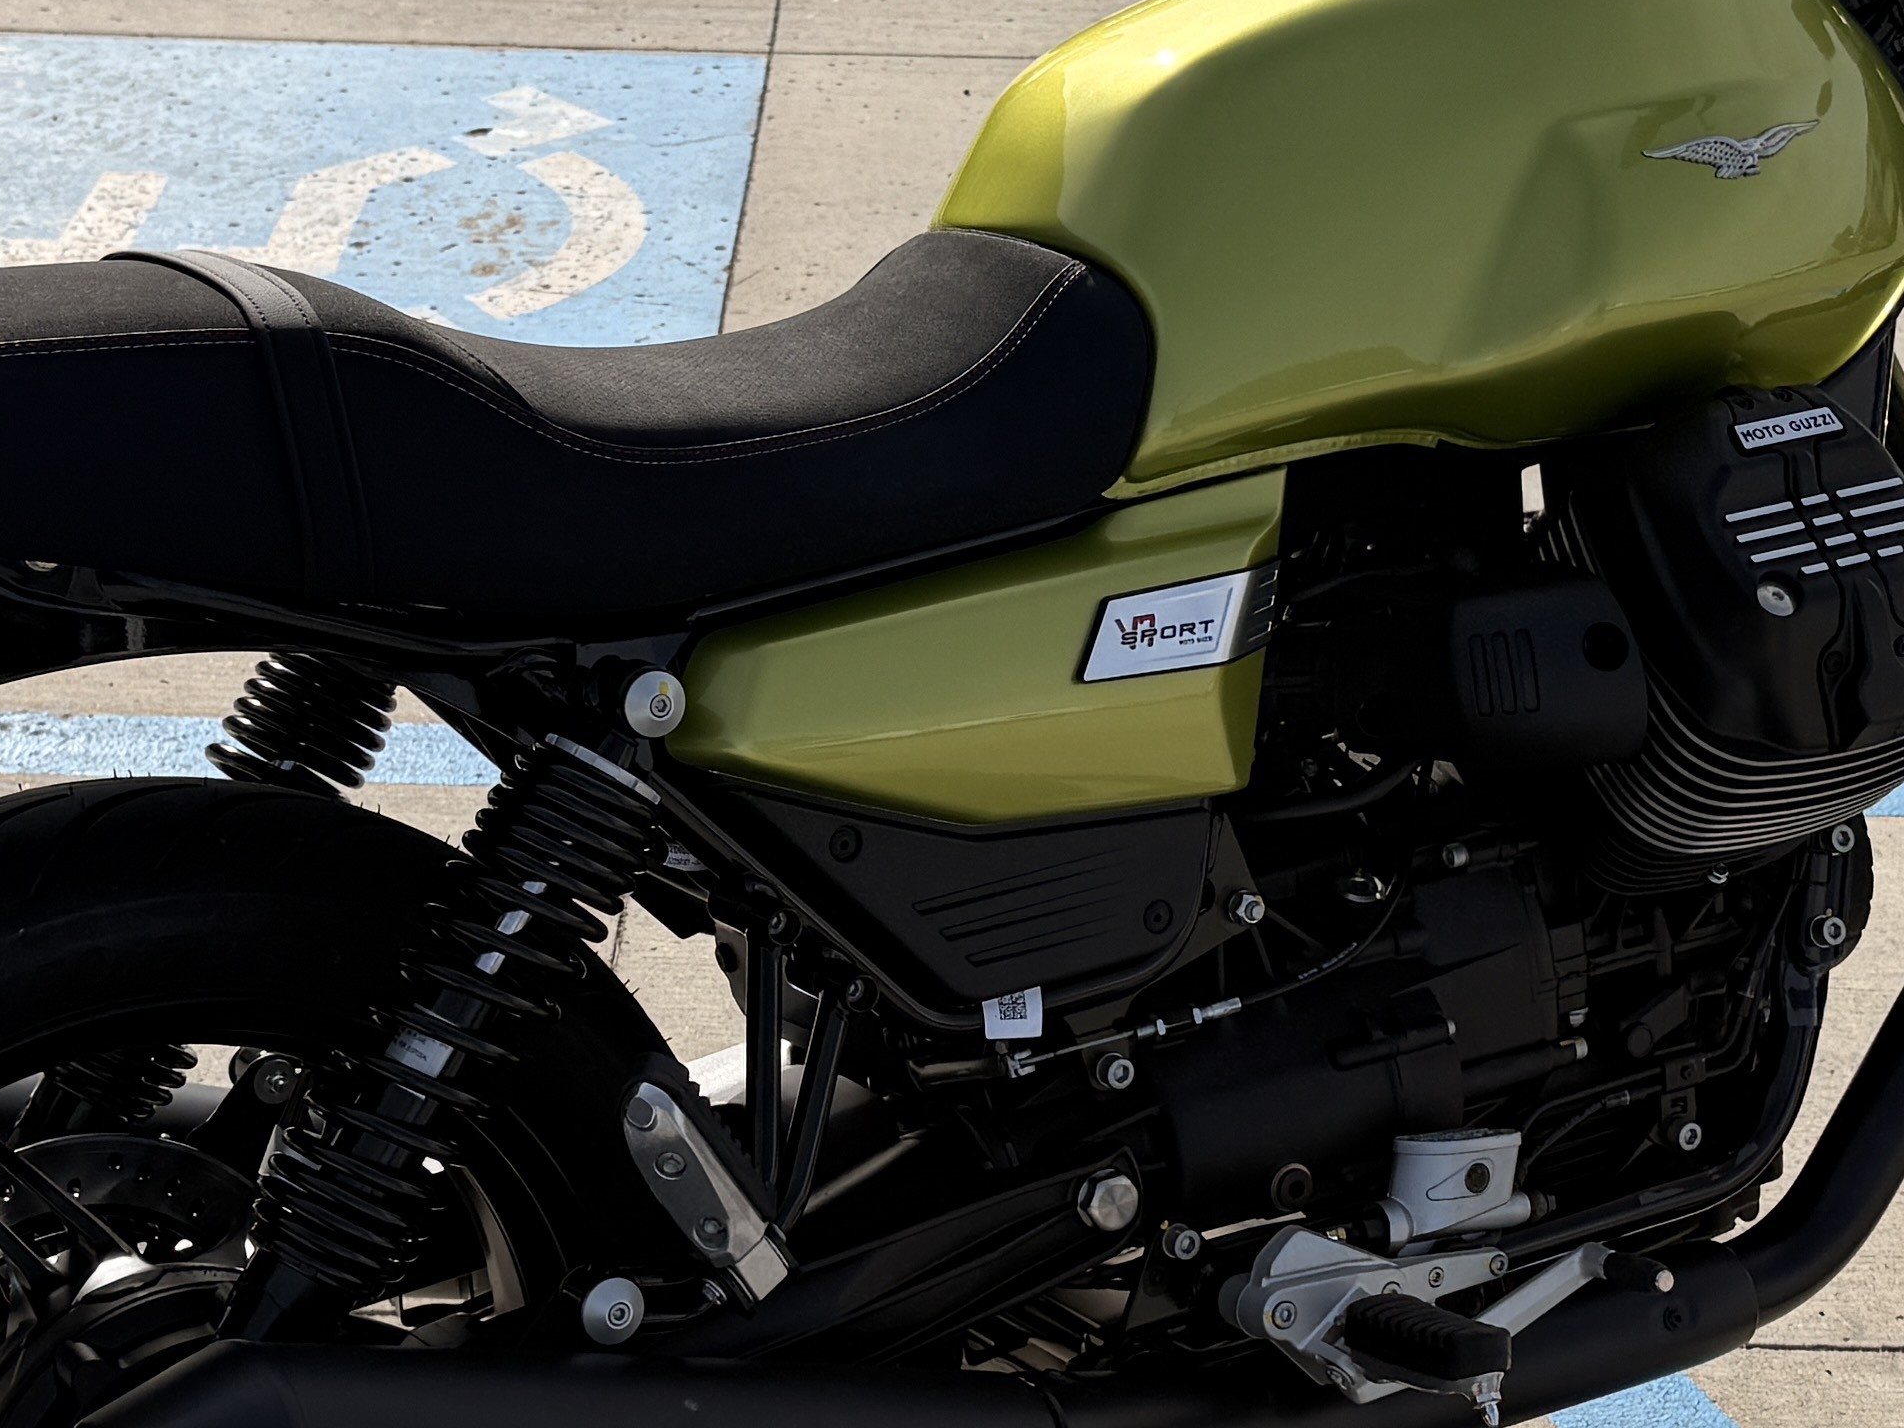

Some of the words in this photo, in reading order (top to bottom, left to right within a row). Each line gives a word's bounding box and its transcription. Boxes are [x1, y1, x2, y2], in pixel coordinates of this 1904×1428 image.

[1739, 425, 1785, 443] MOTO
[1788, 413, 1836, 432] GUZZI
[1121, 619, 1215, 646] SPORT
